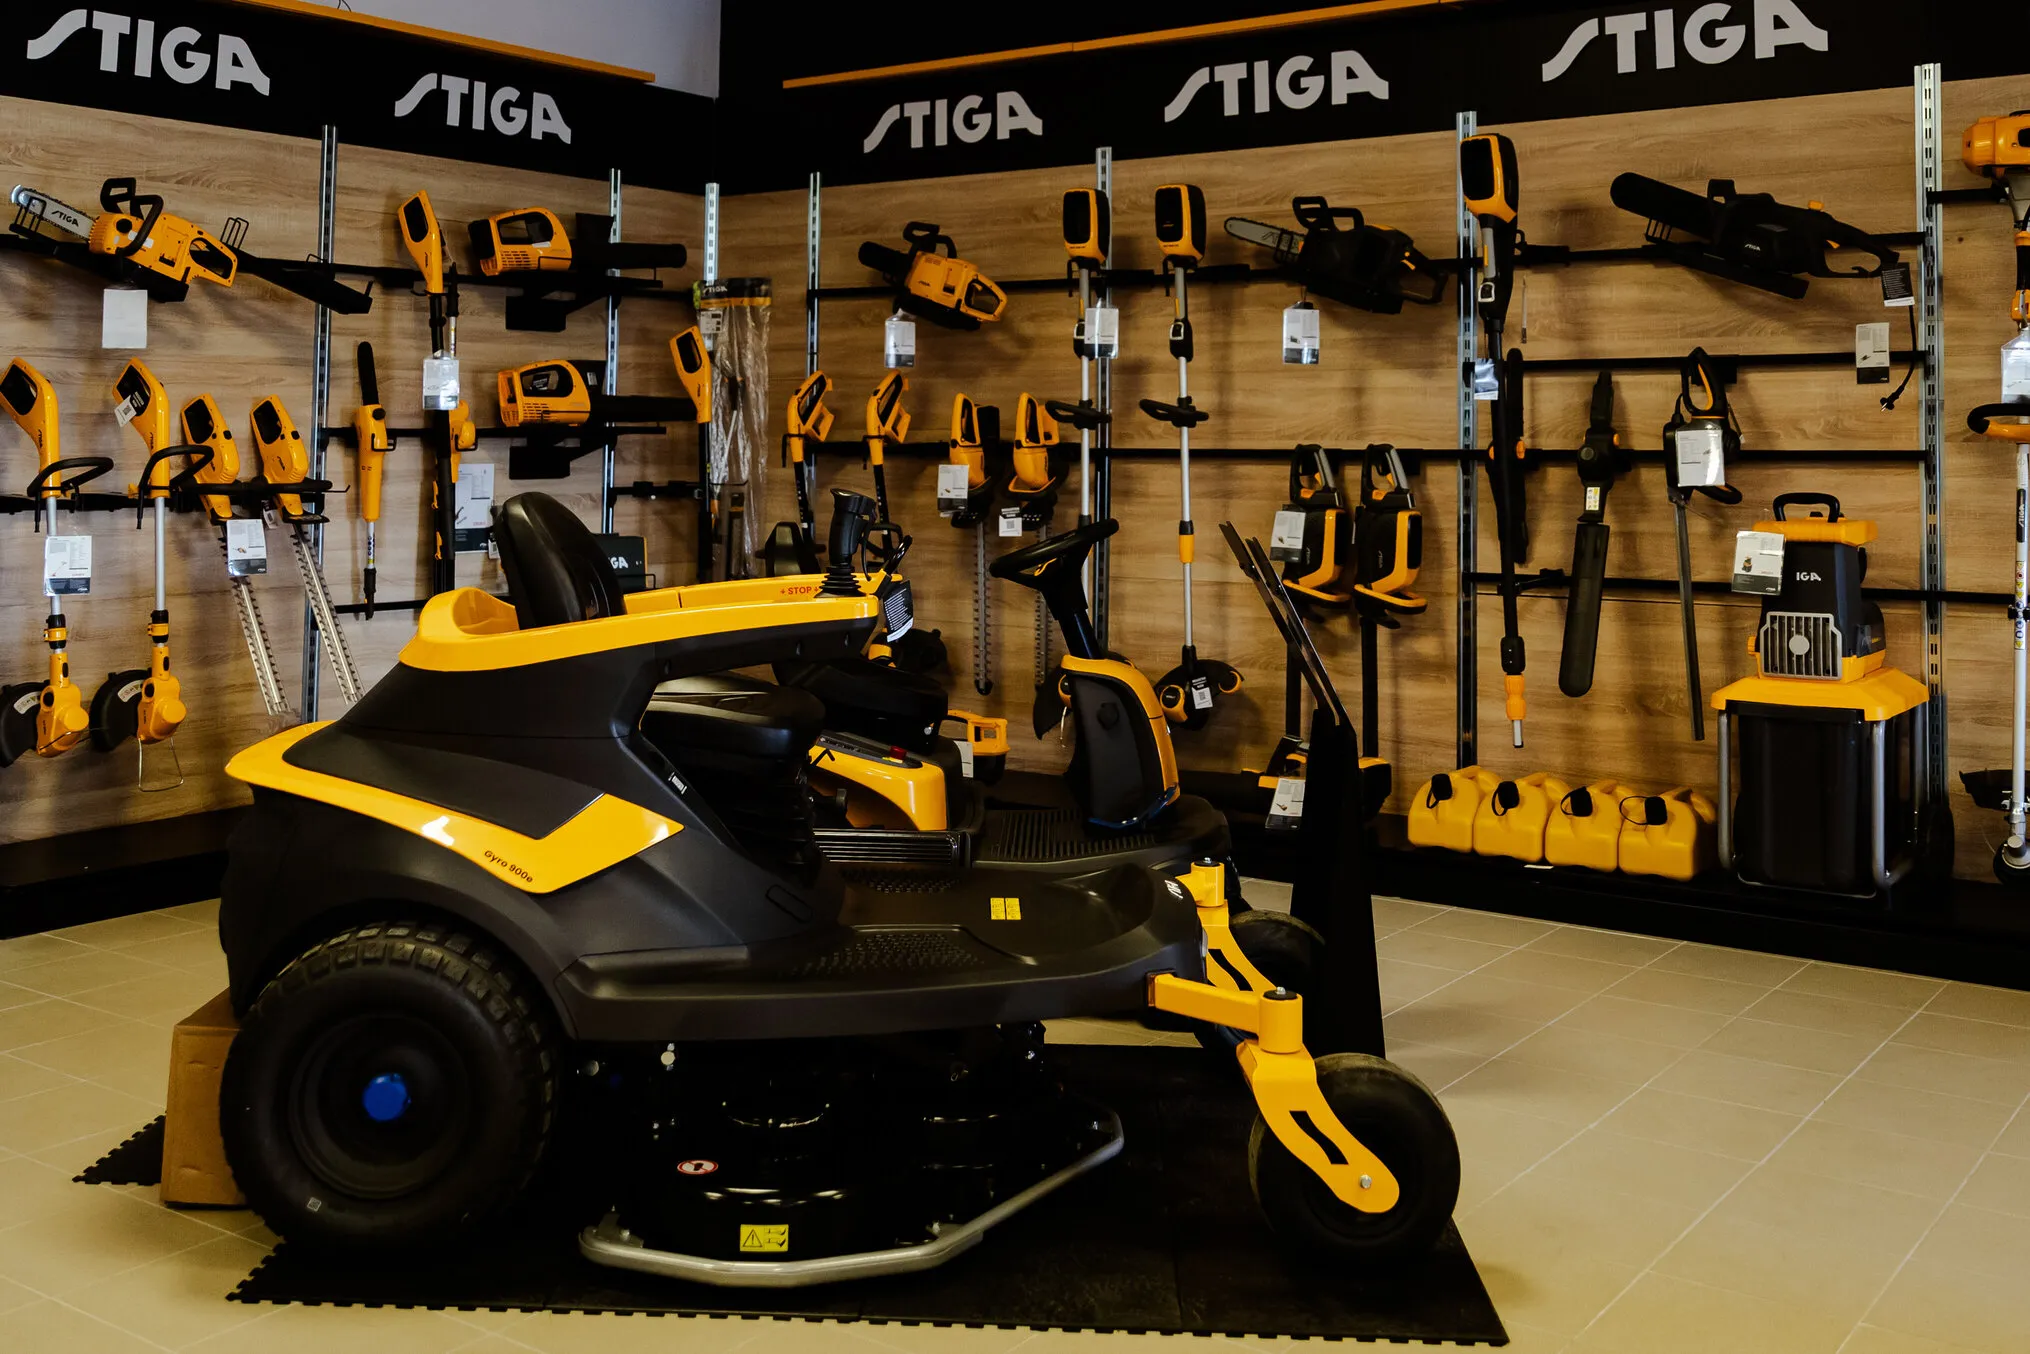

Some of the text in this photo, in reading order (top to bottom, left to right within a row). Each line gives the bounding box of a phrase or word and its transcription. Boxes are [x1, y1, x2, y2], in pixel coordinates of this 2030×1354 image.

[27, 8, 270, 96] STIGA
[1543, 0, 1828, 82] STIGA
[395, 73, 571, 144] STIGA
[1165, 50, 1389, 122] STIGA
[864, 91, 1043, 153] STIGA
[51, 210, 79, 228] STIGA
[787, 586, 812, 595] STOP
[484, 850, 533, 883] Gyro 900e
